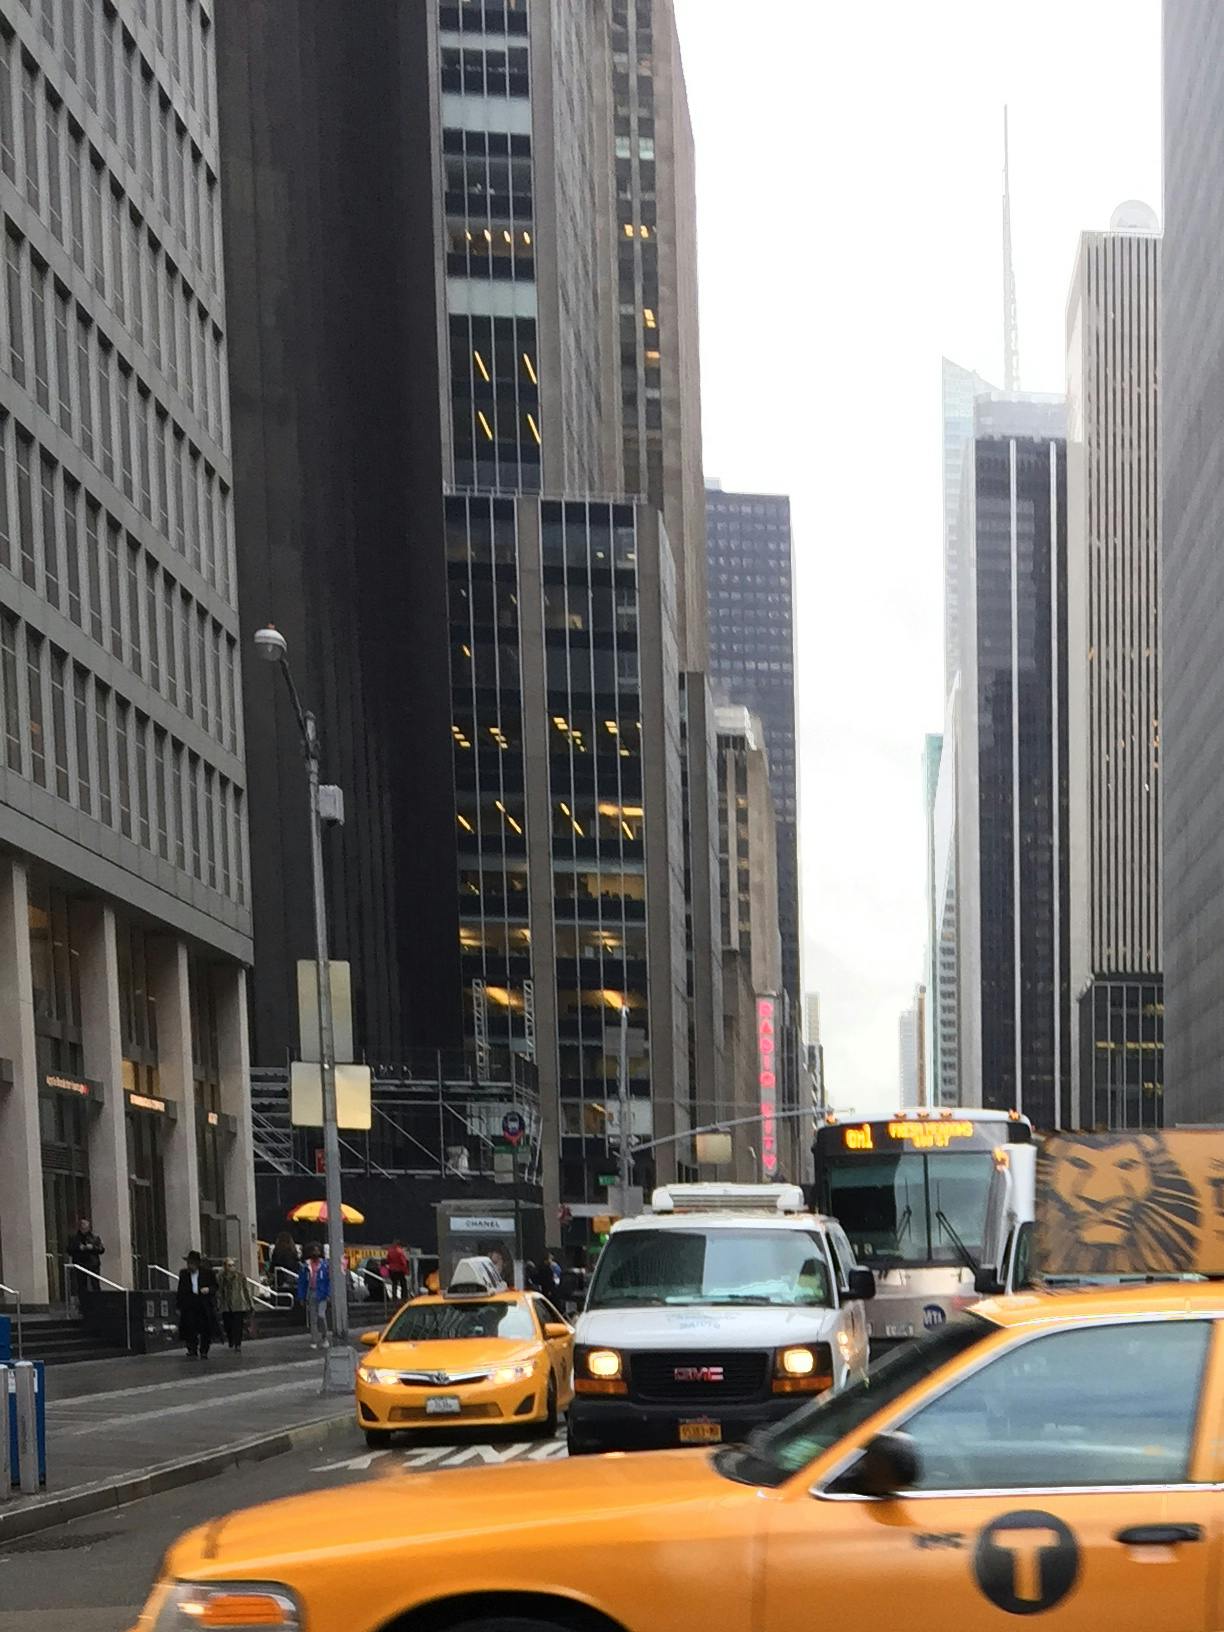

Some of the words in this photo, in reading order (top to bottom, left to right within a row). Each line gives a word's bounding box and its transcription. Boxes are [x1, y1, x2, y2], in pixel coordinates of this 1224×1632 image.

[757, 1001, 776, 1089] RADIO
[760, 1102, 777, 1170] CITY
[465, 1219, 501, 1228] CHANEL
[674, 1367, 724, 1381] GMC
